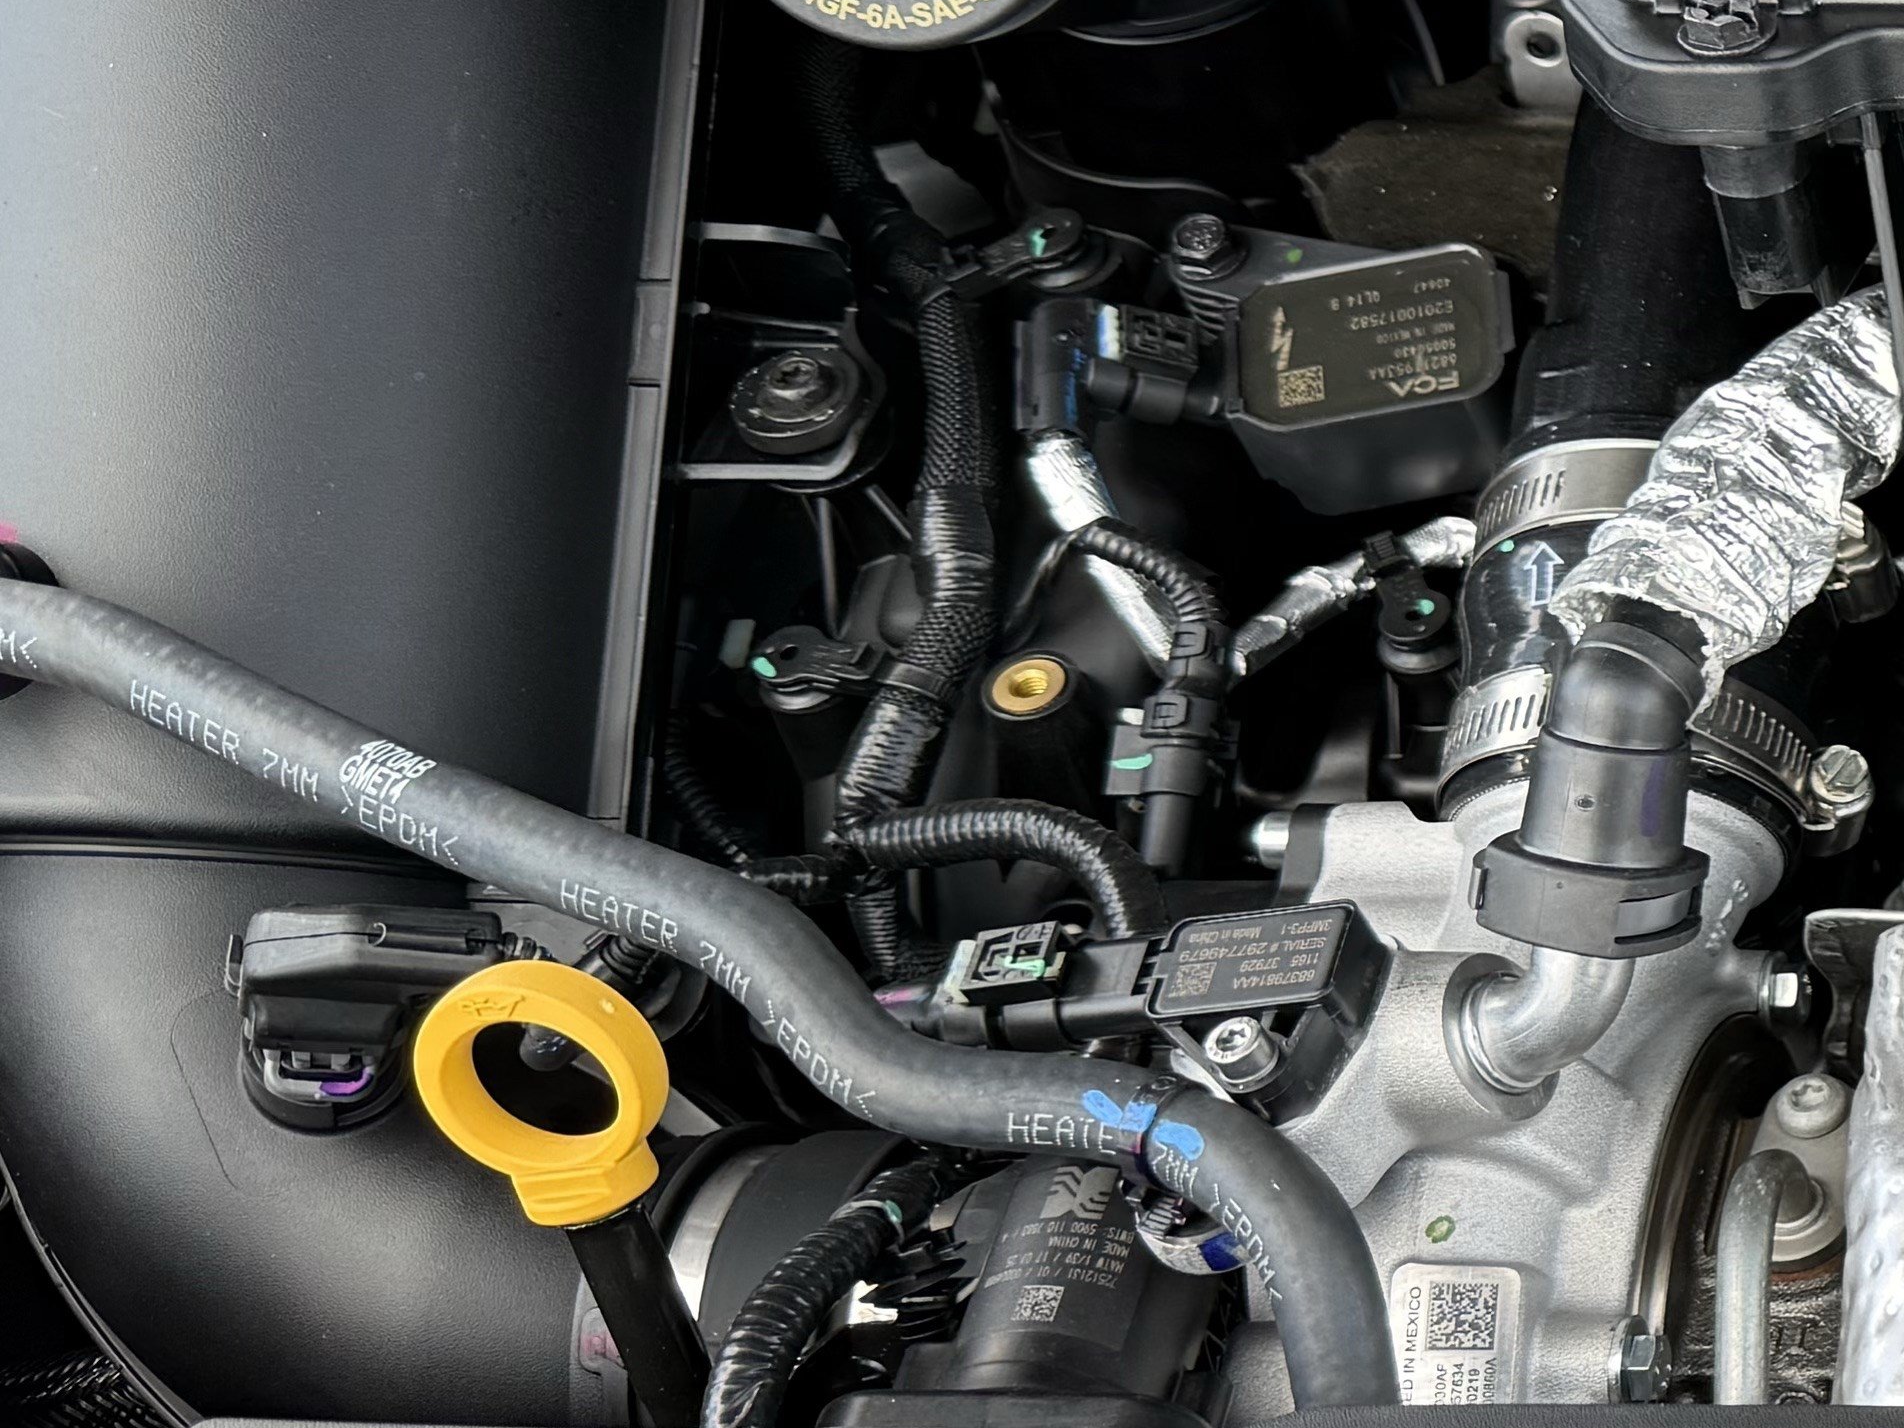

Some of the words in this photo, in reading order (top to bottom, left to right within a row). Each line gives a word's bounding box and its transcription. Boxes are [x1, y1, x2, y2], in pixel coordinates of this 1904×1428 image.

[1384, 370, 1460, 397] FCA
[130, 679, 241, 766] HEATER
[559, 878, 679, 954] HEATER
[1188, 931, 1220, 945] China
[1221, 929, 1232, 939] in
[1232, 926, 1262, 940] Made
[1284, 937, 1327, 952] SERIAL
[1007, 1112, 1117, 1156] HEATE
[1048, 1235, 1081, 1249] CHINA
[1083, 1238, 1098, 1251] IN
[1102, 1241, 1130, 1258] MADE
[1404, 1285, 1422, 1352] MEXICO
[1403, 1357, 1416, 1374] IN
